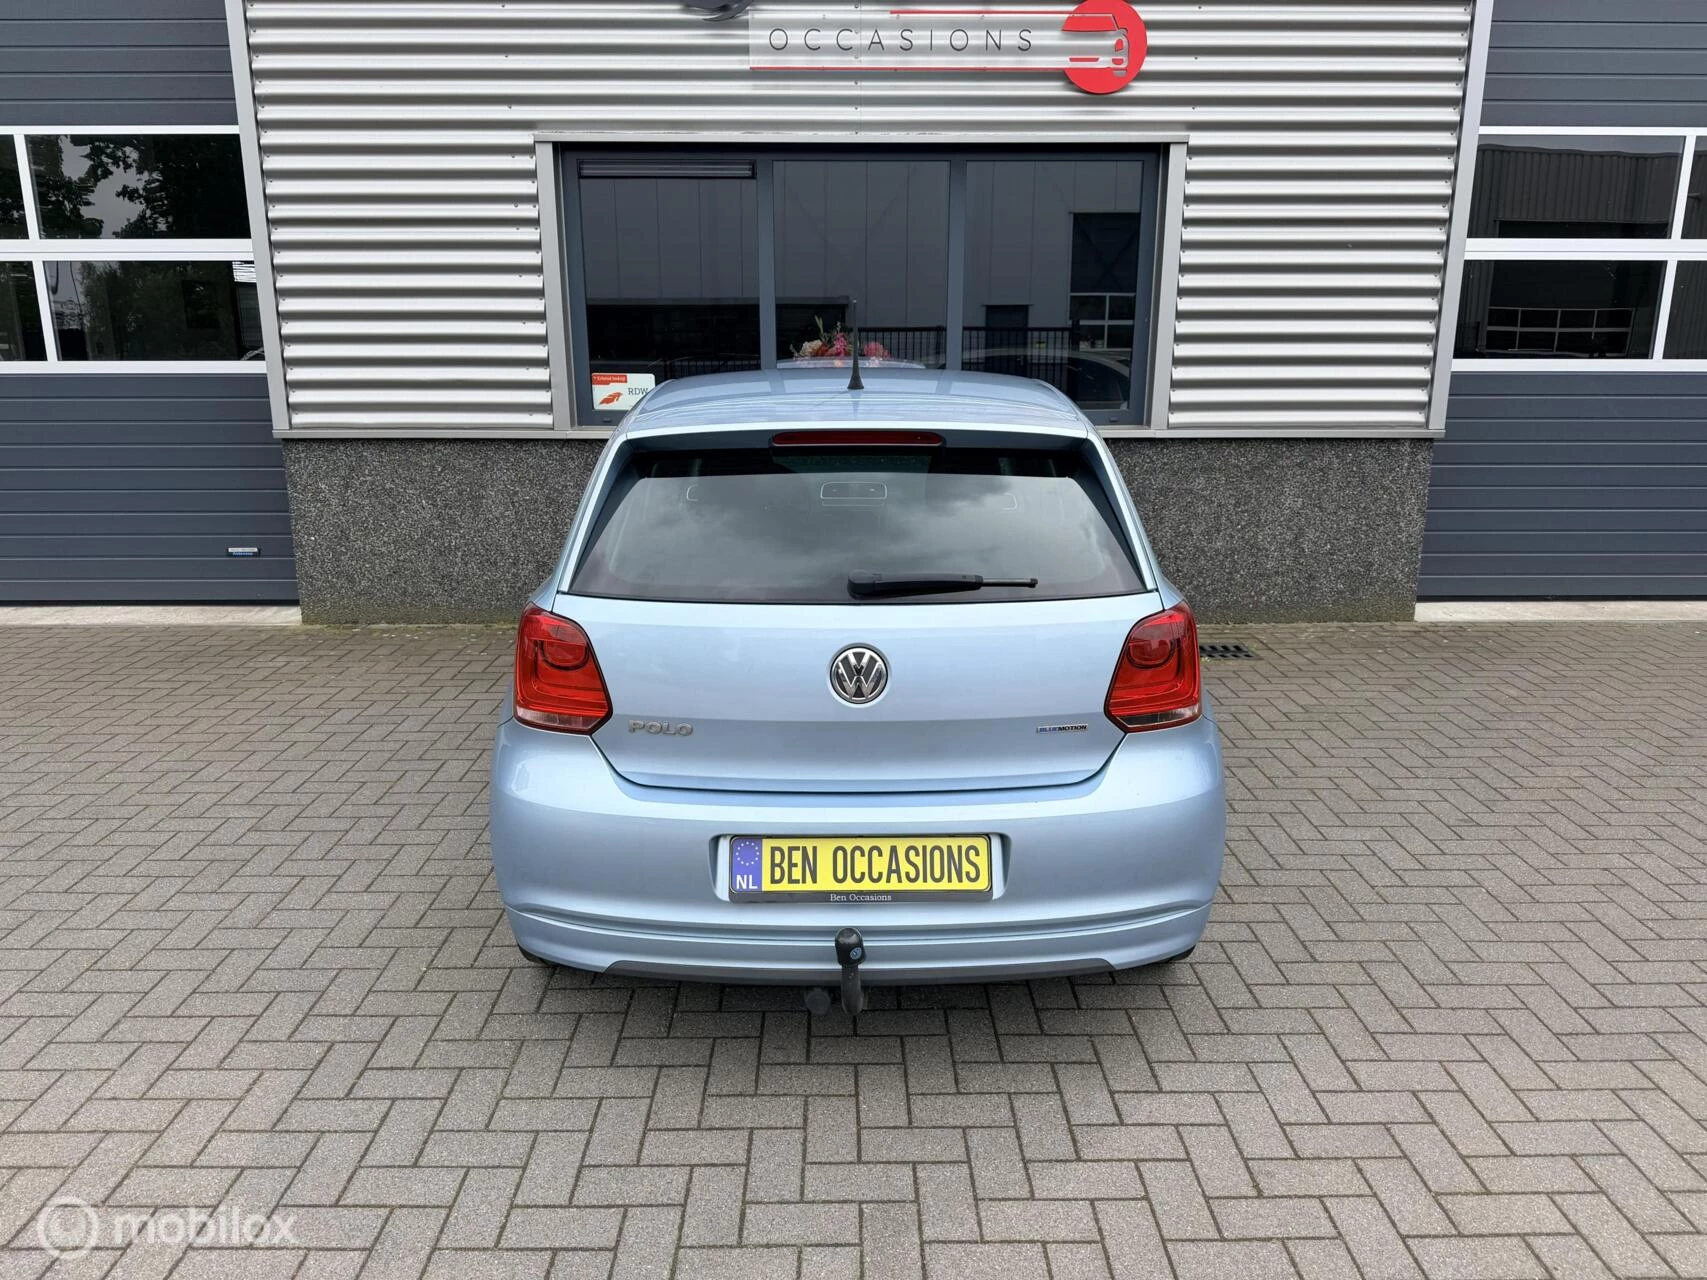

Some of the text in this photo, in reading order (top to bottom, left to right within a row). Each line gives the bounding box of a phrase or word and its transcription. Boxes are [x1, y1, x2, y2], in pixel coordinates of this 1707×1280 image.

[769, 28, 1032, 52] OCCASIONS
[627, 387, 649, 396] RDW
[629, 719, 694, 737] POLO
[769, 844, 981, 885] BEN OCCASIONS
[736, 874, 758, 890] NL
[830, 893, 892, 901] Ben Occasions
